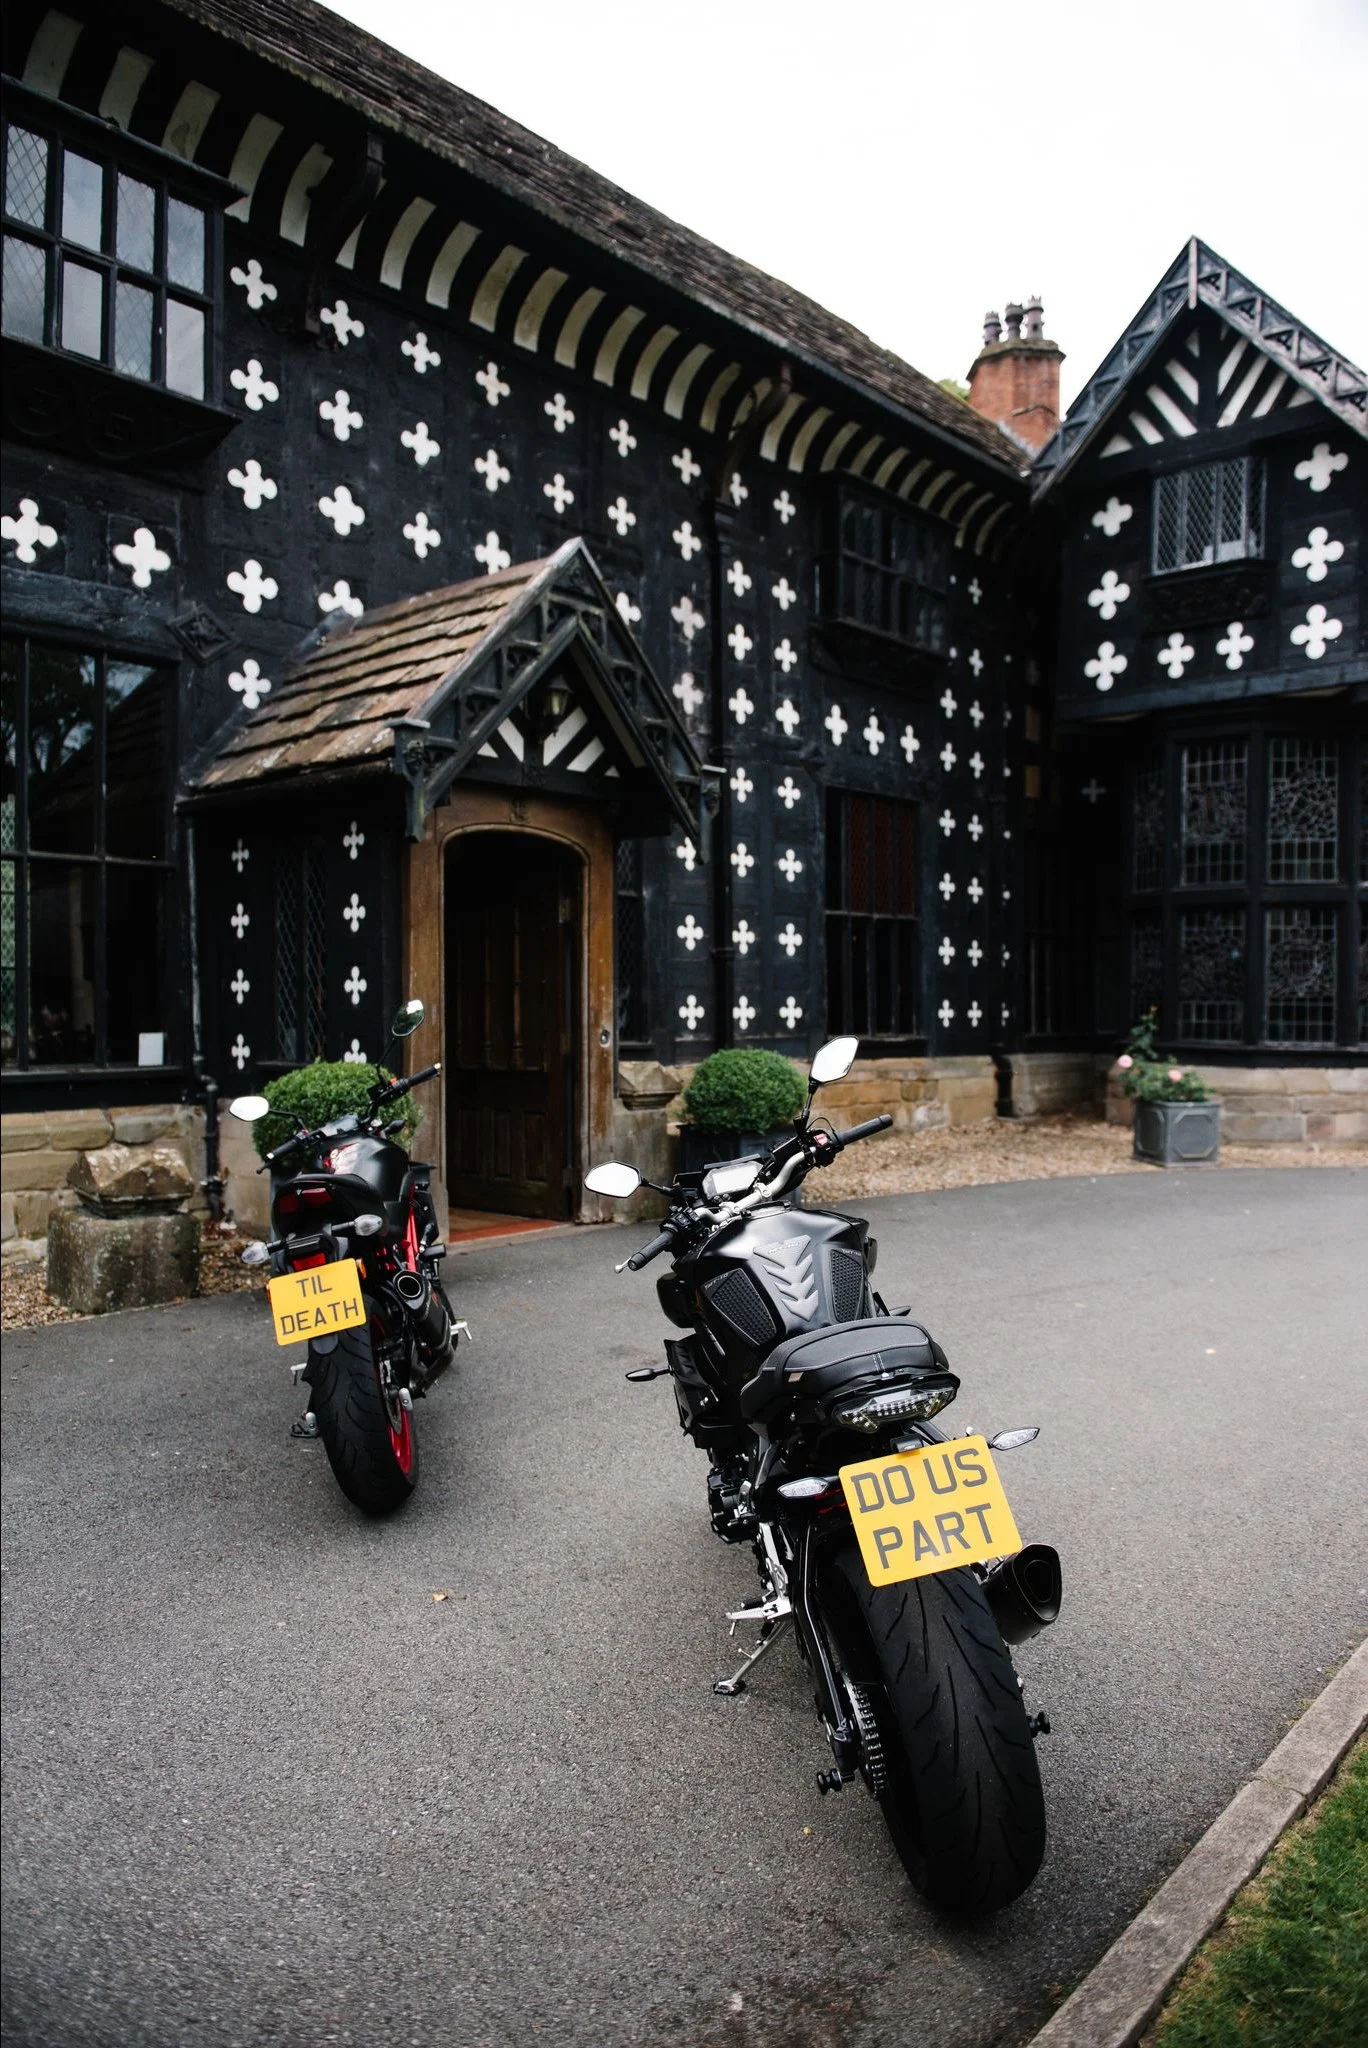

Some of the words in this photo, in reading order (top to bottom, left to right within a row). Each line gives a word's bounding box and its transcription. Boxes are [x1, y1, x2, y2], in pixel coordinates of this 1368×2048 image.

[296, 1274, 333, 1298] TIL
[280, 1298, 359, 1335] DEATH
[851, 1464, 915, 1514] DO
[922, 1448, 988, 1495] US
[872, 1502, 993, 1569] PART
